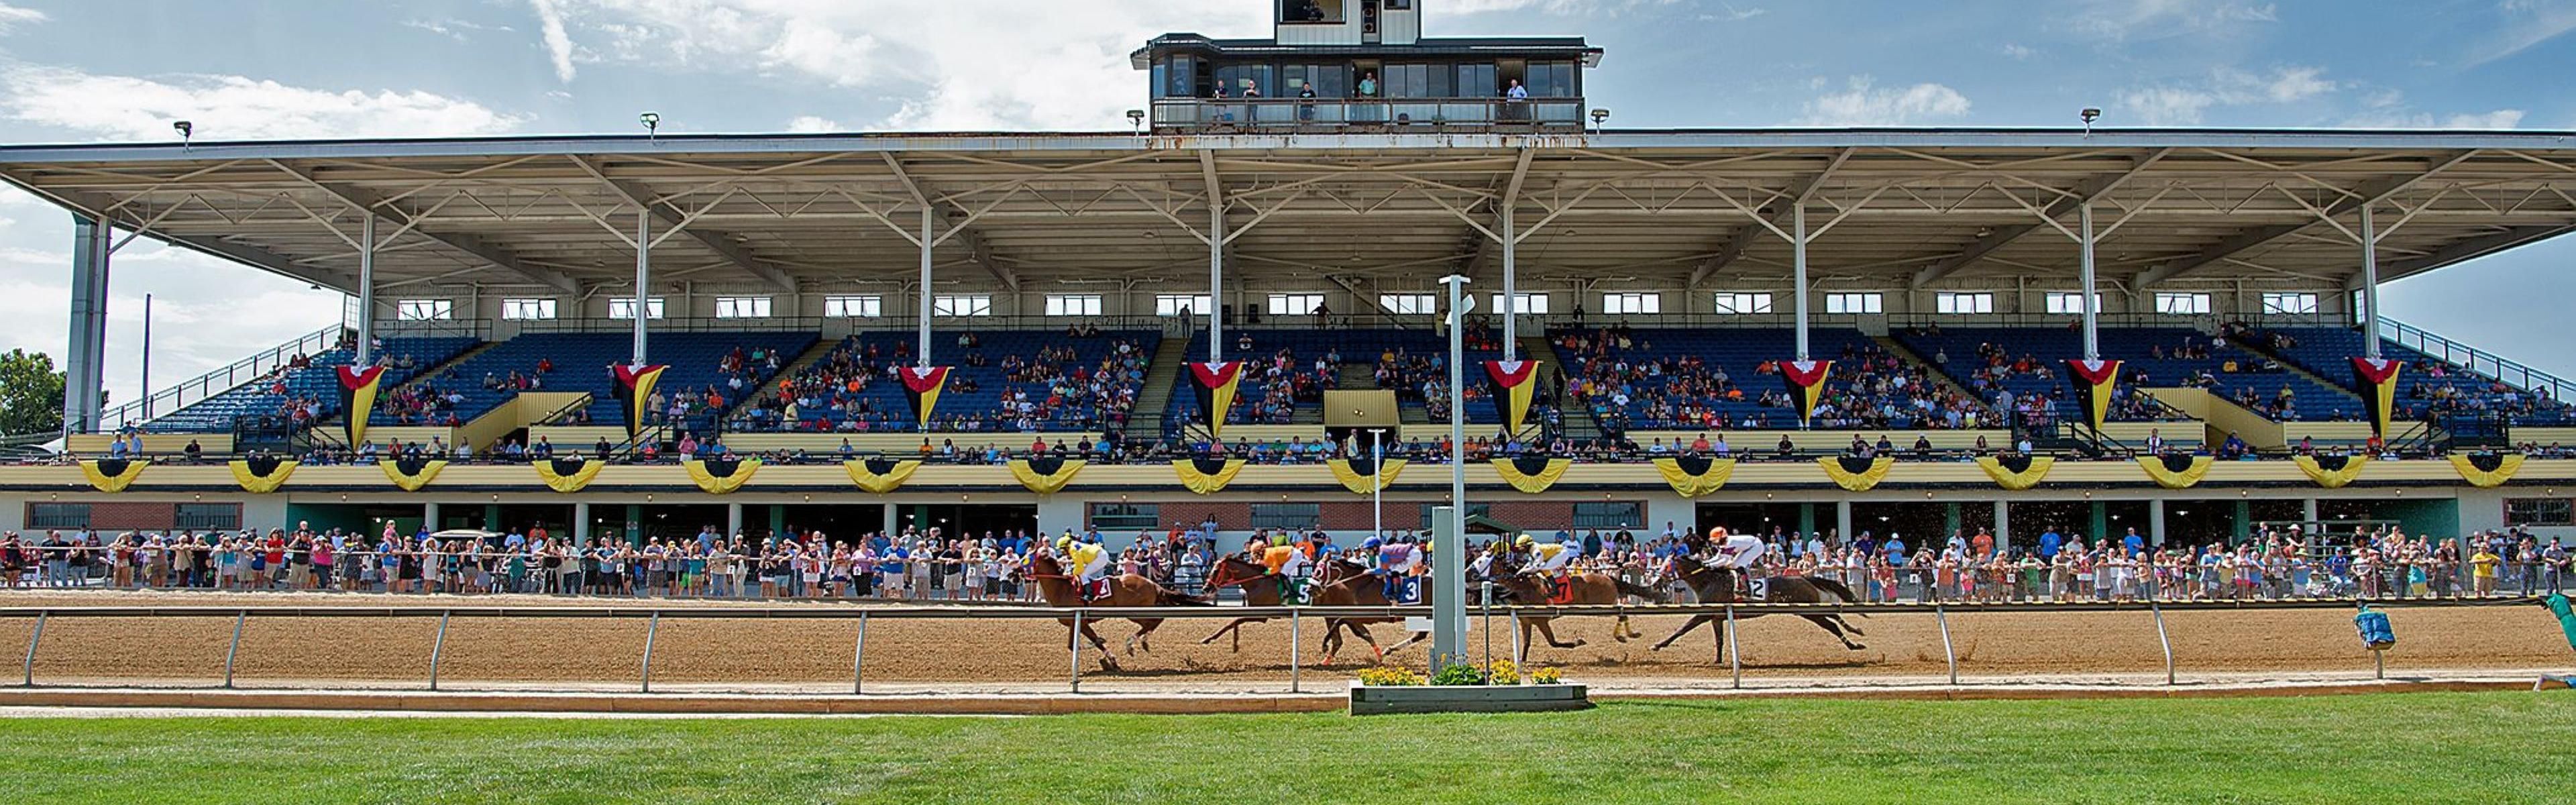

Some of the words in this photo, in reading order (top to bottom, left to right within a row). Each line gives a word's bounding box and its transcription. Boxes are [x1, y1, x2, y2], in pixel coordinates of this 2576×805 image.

[1297, 584, 1309, 603] 5
[1405, 582, 1417, 600] 3
[1556, 583, 1568, 600] 7
[1753, 581, 1763, 598] 2
